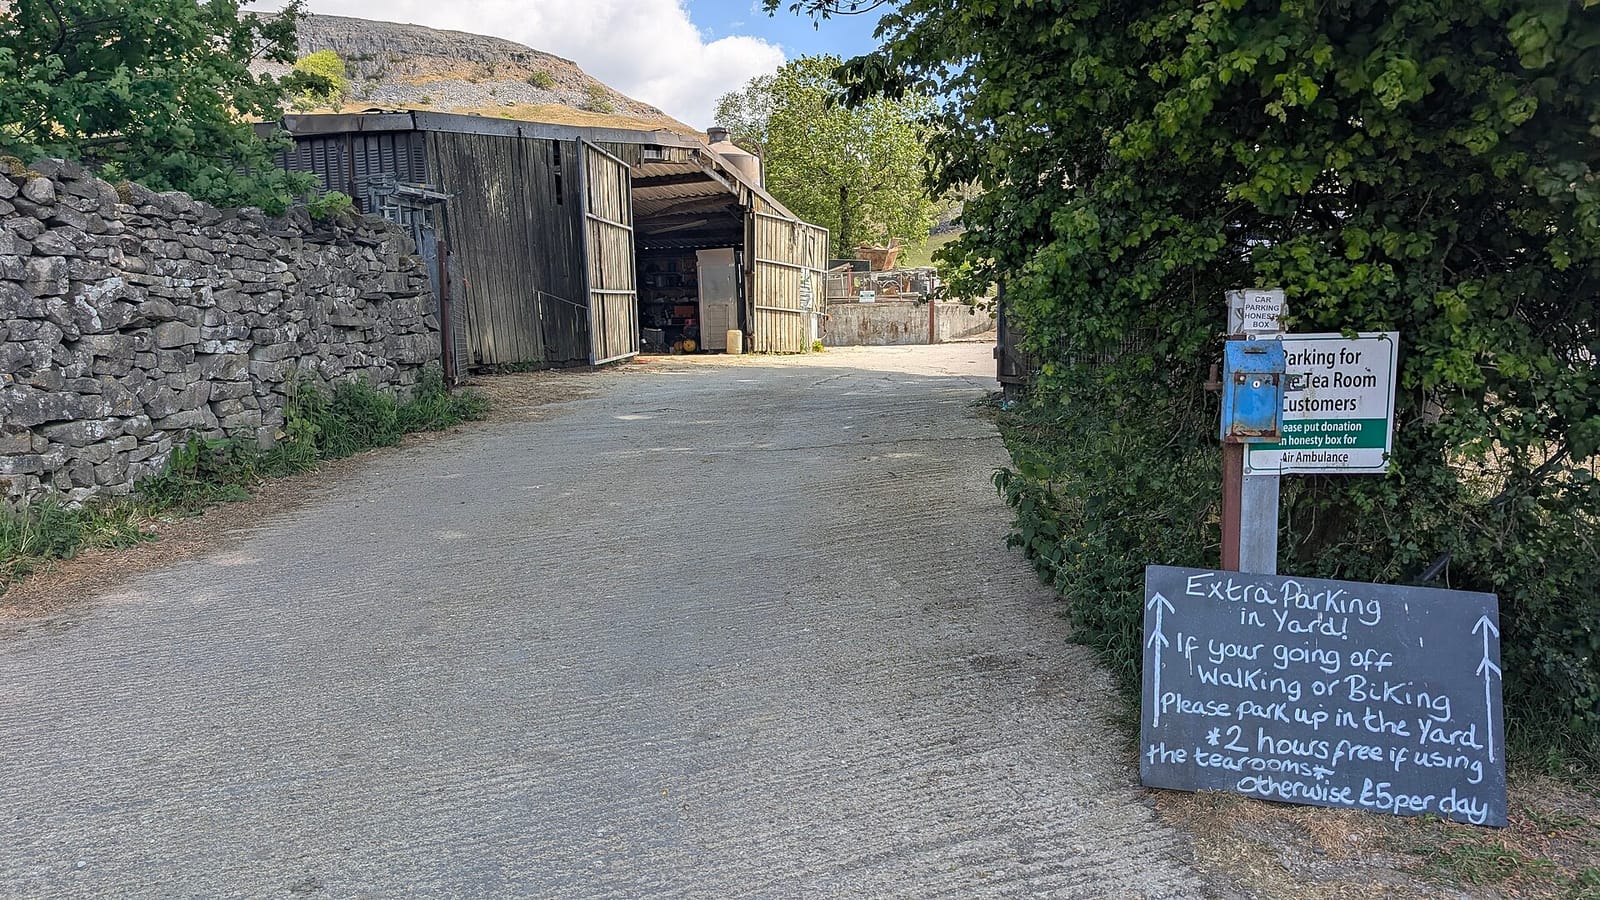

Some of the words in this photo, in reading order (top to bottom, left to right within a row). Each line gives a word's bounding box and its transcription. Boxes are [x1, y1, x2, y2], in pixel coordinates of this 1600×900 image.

[1340, 347, 1361, 365] for
[1304, 372, 1329, 389] Tea
[1333, 371, 1377, 388] Room
[1283, 423, 1302, 432] ease
[1304, 422, 1320, 434] put
[1321, 421, 1362, 432] donation
[1288, 435, 1323, 447] honesty
[1325, 434, 1341, 445] box
[1343, 434, 1357, 444] for
[1282, 452, 1295, 462] Air
[1296, 451, 1349, 463] Ambulance
[1185, 572, 1277, 603] Extra
[1240, 608, 1266, 627] in
[1272, 609, 1349, 640] Yard!
[1177, 632, 1199, 660] If
[1208, 639, 1265, 665] your
[1273, 644, 1341, 674] going
[1350, 648, 1393, 672] off
[1311, 679, 1340, 696] or
[1160, 692, 1232, 717] Please
[1294, 706, 1329, 731] up
[1335, 708, 1359, 729] in
[1362, 706, 1411, 737] the
[1146, 742, 1188, 765] the
[1257, 727, 1329, 760] hours
[1331, 739, 1384, 767] free
[1389, 747, 1409, 773] if
[1413, 751, 1484, 785] using
[1438, 787, 1488, 825] day
